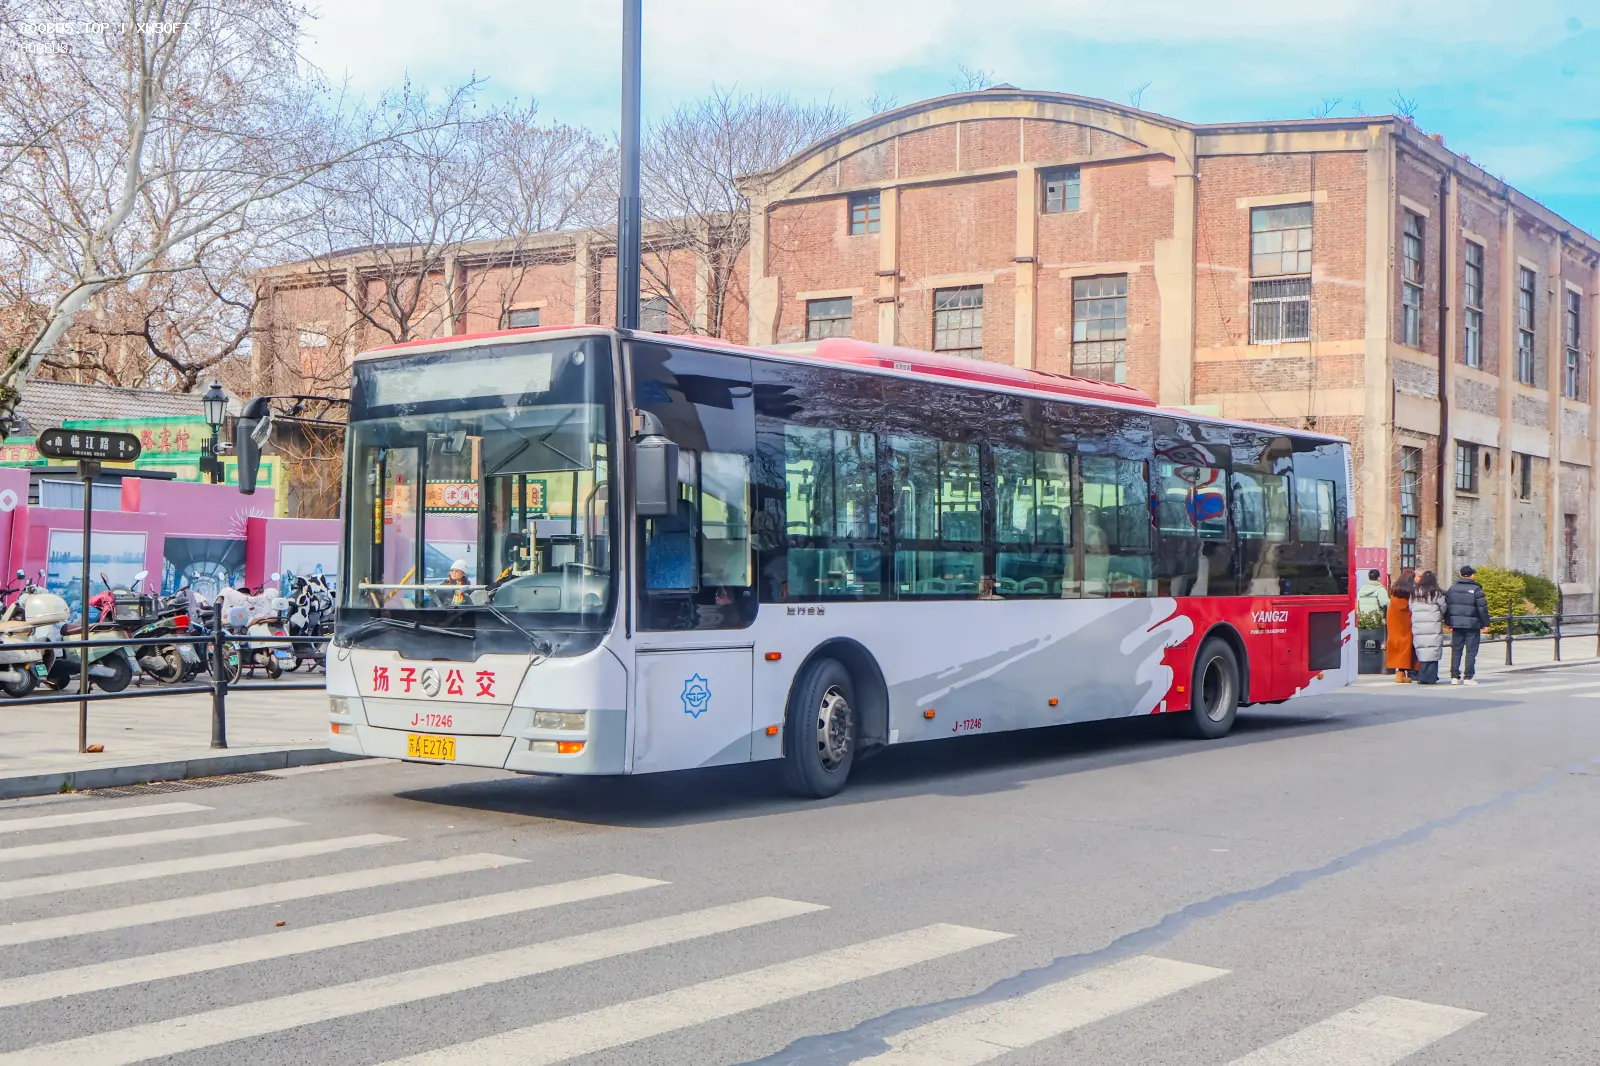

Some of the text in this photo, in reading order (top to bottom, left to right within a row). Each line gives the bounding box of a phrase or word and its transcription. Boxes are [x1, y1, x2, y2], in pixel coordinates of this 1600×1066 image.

[55, 434, 126, 451] 南 临江路 北
[1251, 610, 1289, 623] YANGZI
[411, 713, 453, 728] J-17246
[952, 718, 982, 732] J-17246
